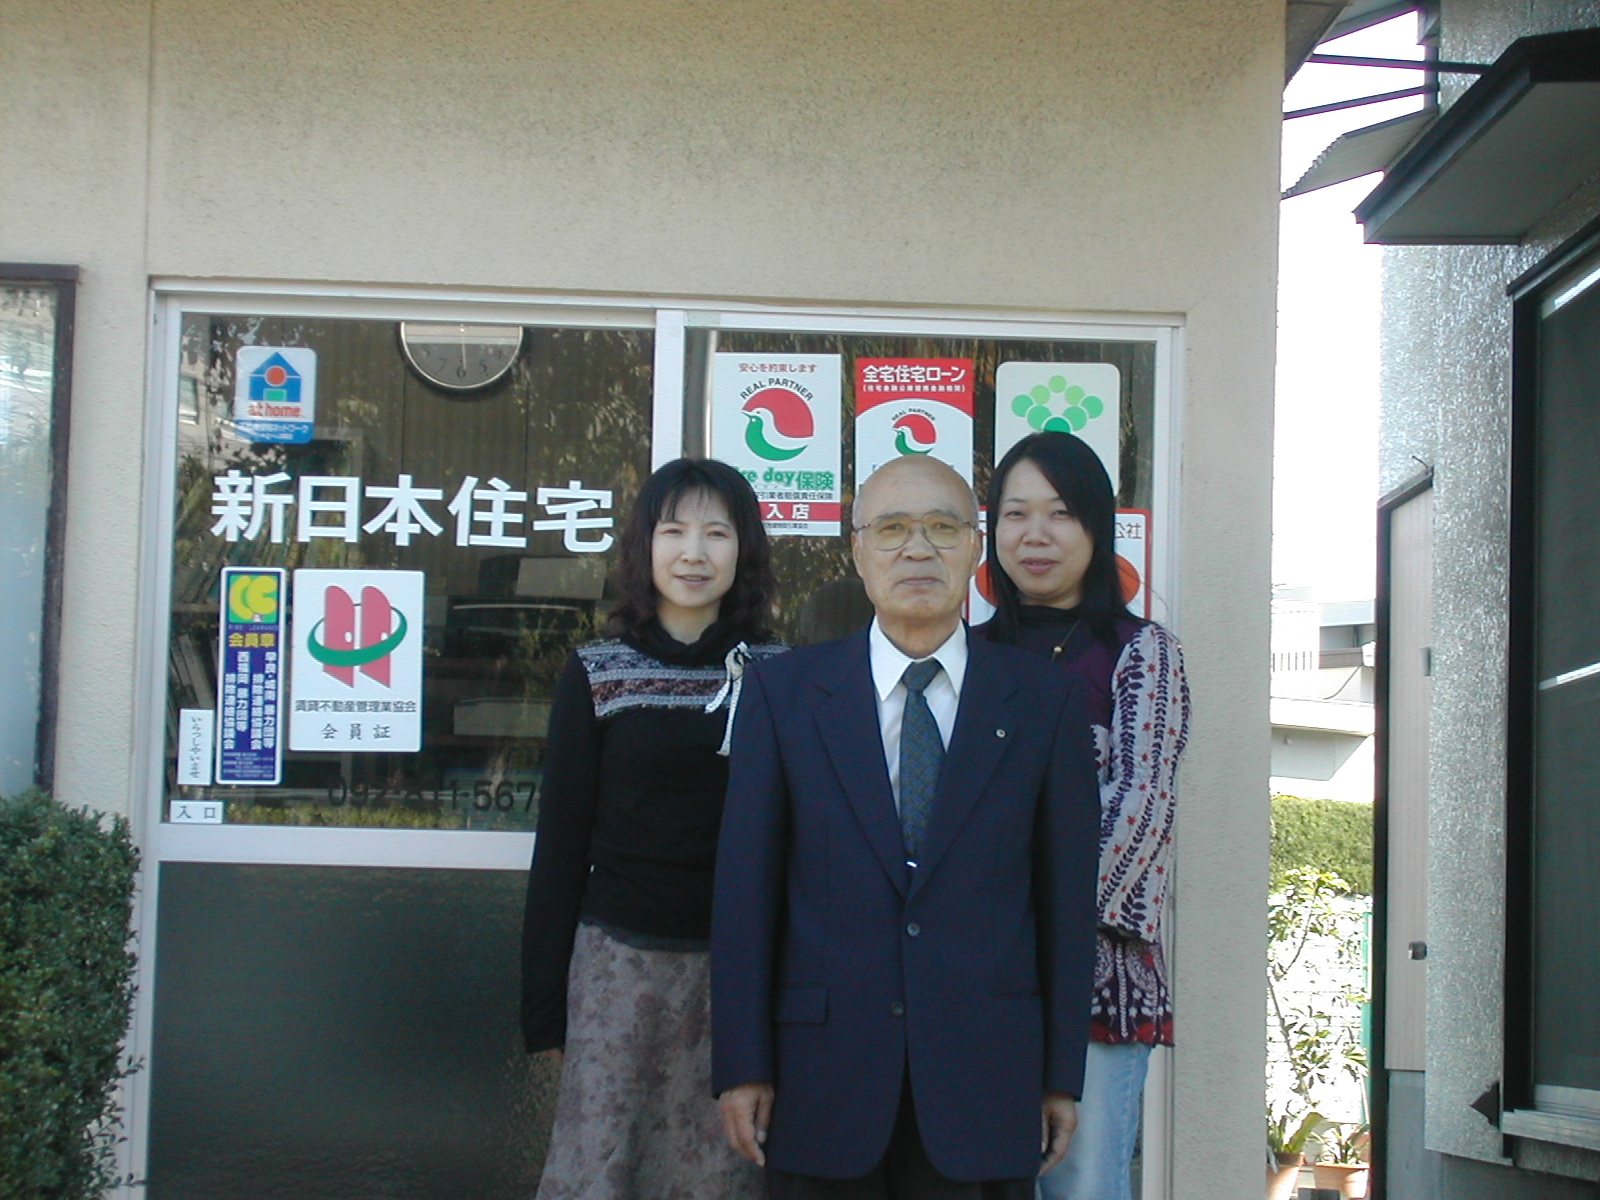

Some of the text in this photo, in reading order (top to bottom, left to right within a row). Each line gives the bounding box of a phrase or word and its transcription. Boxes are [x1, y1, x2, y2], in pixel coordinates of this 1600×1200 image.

[739, 363, 817, 373] 安心を約束します
[863, 365, 966, 383] 全宅住宅ローン
[740, 378, 813, 401] REAL PARTNER
[210, 469, 614, 553] 新日本住宅
[766, 503, 809, 520] 入店
[321, 723, 391, 740] 会員証
[177, 805, 216, 819] 入口
